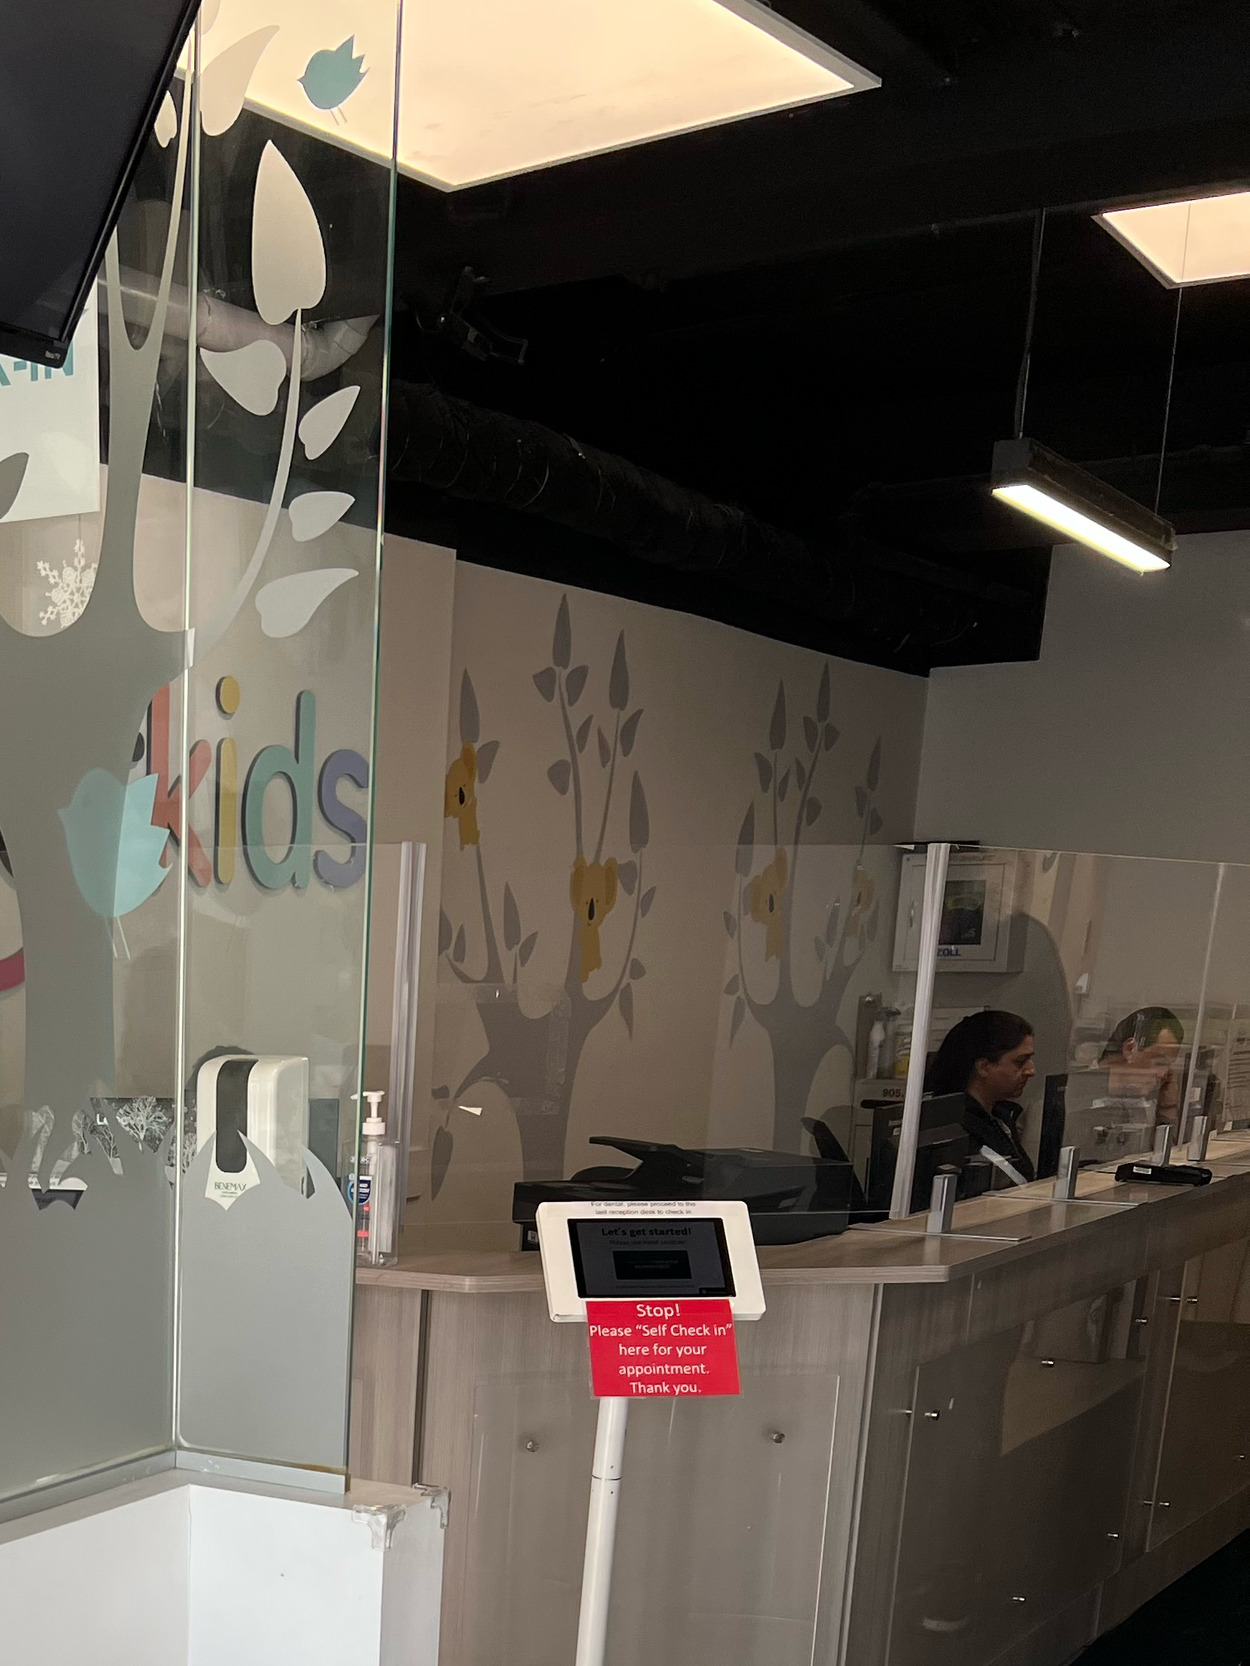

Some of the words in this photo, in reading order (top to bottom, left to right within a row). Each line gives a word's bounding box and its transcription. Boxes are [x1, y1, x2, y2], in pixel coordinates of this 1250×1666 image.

[601, 1227, 627, 1236] Let's
[629, 1228, 646, 1238] get
[648, 1227, 692, 1236] started!
[636, 1303, 680, 1318] Stop!
[589, 1324, 632, 1337] Please
[670, 1323, 711, 1336] Check
[619, 1343, 650, 1356] here
[652, 1343, 673, 1356] for
[675, 1345, 707, 1358] your
[618, 1363, 710, 1376] appointment.
[630, 1382, 670, 1394] Thank
[672, 1383, 702, 1396] you.
